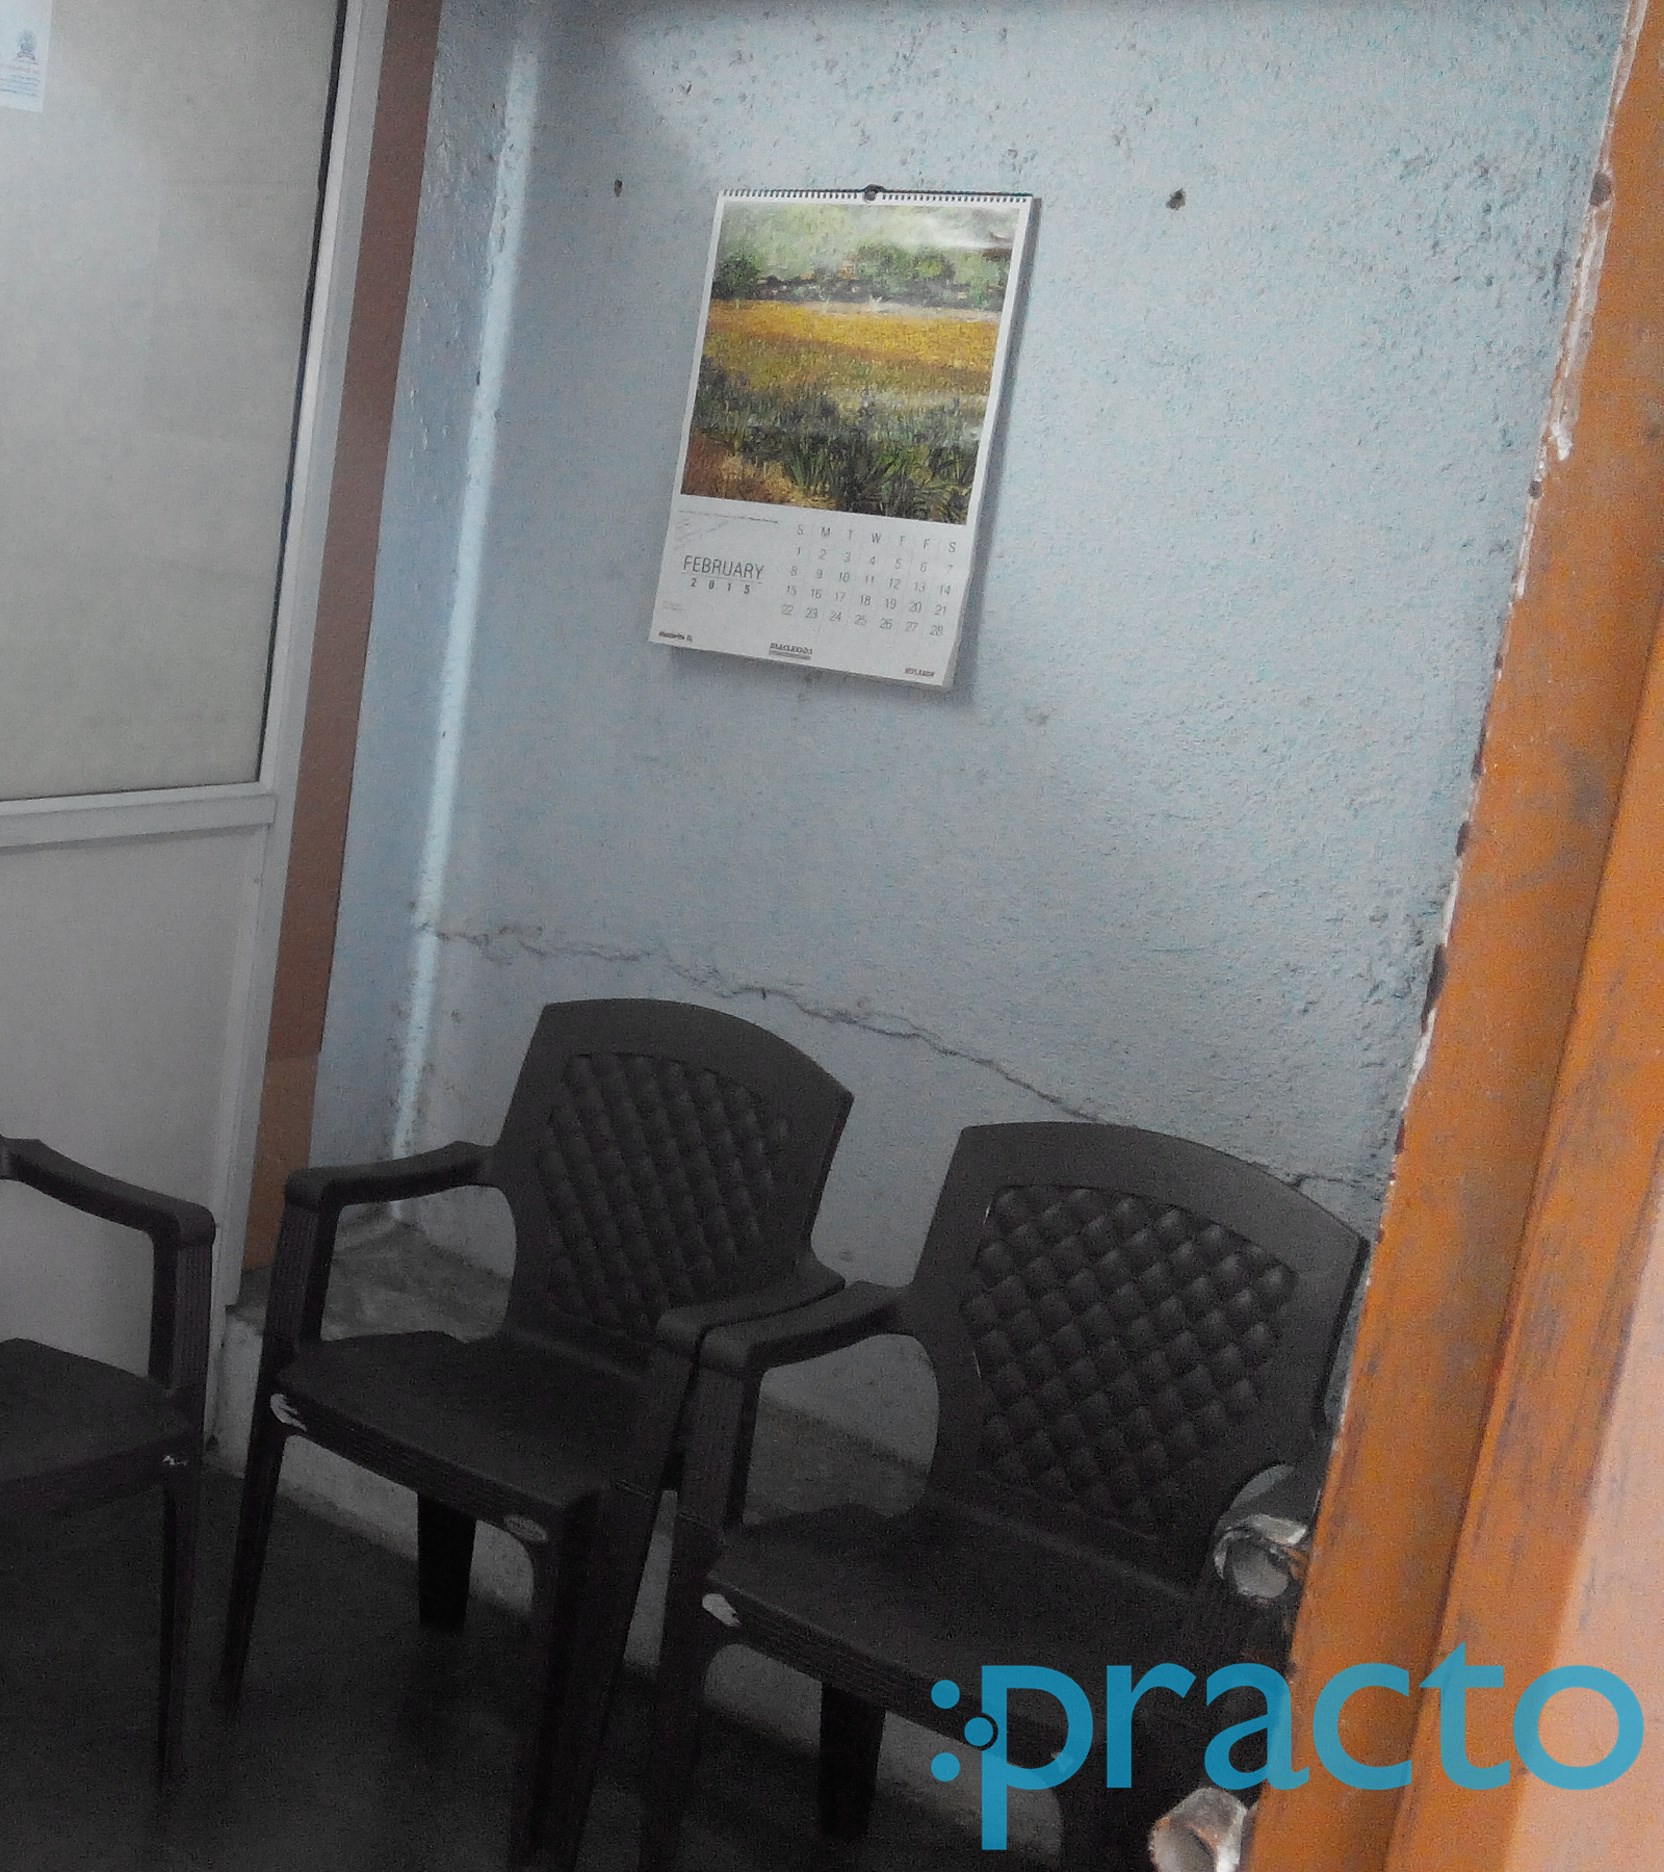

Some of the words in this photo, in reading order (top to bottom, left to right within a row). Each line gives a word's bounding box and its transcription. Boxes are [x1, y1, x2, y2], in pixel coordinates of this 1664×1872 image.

[797, 524, 804, 535] S
[821, 527, 830, 537] M
[849, 530, 854, 540] T
[872, 533, 881, 543] W
[923, 538, 930, 549] F
[949, 542, 956, 553] S
[683, 555, 764, 579] FEBRUARY
[797, 547, 801, 556] 1
[819, 549, 826, 560] 2
[844, 552, 851, 563] 3
[869, 556, 876, 566] 4
[895, 558, 901, 569] 5
[920, 562, 927, 572] 6
[791, 565, 798, 576] 8
[816, 568, 823, 579] 9
[839, 572, 850, 583] 10
[865, 575, 874, 584] 11
[890, 578, 900, 590] 12
[915, 582, 926, 592] 13
[940, 584, 951, 595] 14
[786, 585, 797, 596] 15
[811, 588, 822, 599] 16
[835, 592, 846, 602] 17
[861, 595, 871, 606] 18
[885, 598, 896, 609] 19
[908, 601, 922, 613] 20
[935, 604, 946, 616] 21
[781, 604, 794, 616] 22
[805, 607, 818, 619] 23
[829, 611, 842, 622] 24
[854, 614, 867, 626] 25
[880, 618, 892, 630] 26
[905, 621, 918, 632] 27
[929, 624, 943, 636] 28
